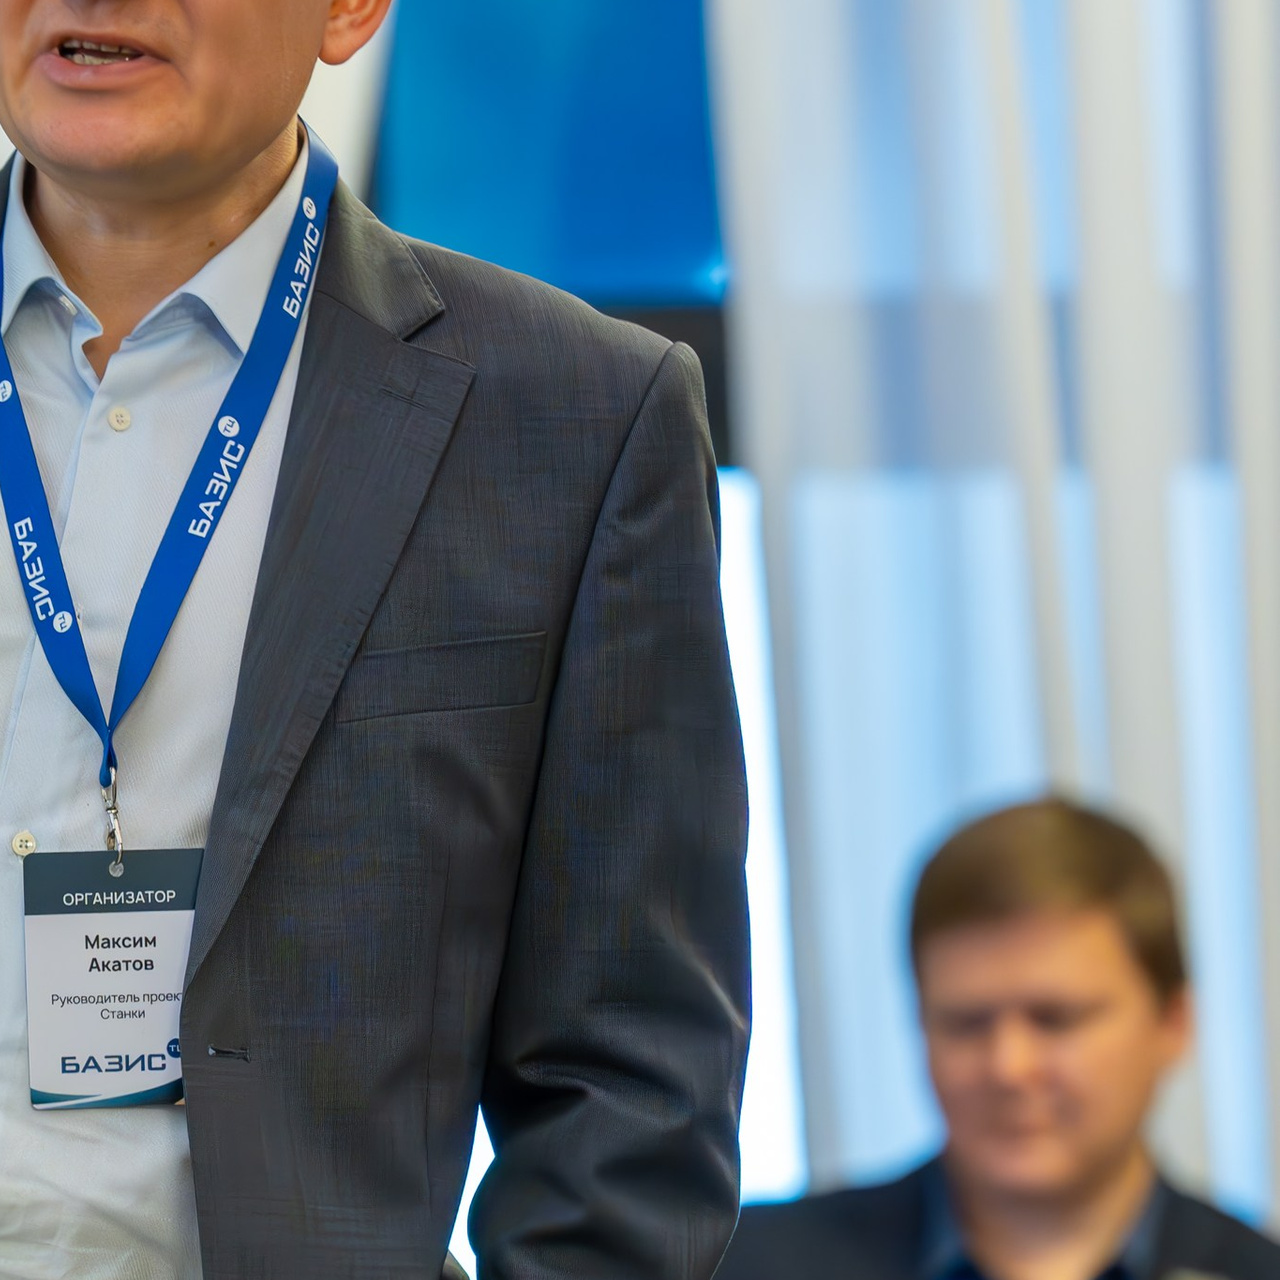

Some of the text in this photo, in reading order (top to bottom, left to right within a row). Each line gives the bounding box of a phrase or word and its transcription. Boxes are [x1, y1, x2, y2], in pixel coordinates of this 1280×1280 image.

[282, 222, 320, 319] БАЗИС
[187, 439, 245, 538] БАЗИС
[13, 516, 55, 621] БАЗИС
[62, 889, 176, 907] ОРГАНИЗАТОР
[84, 934, 157, 950] Максим
[88, 957, 155, 973] Акатов
[51, 992, 140, 1008] Руководитель
[100, 1008, 146, 1020] Станки
[61, 1053, 167, 1074] БАЗИС
